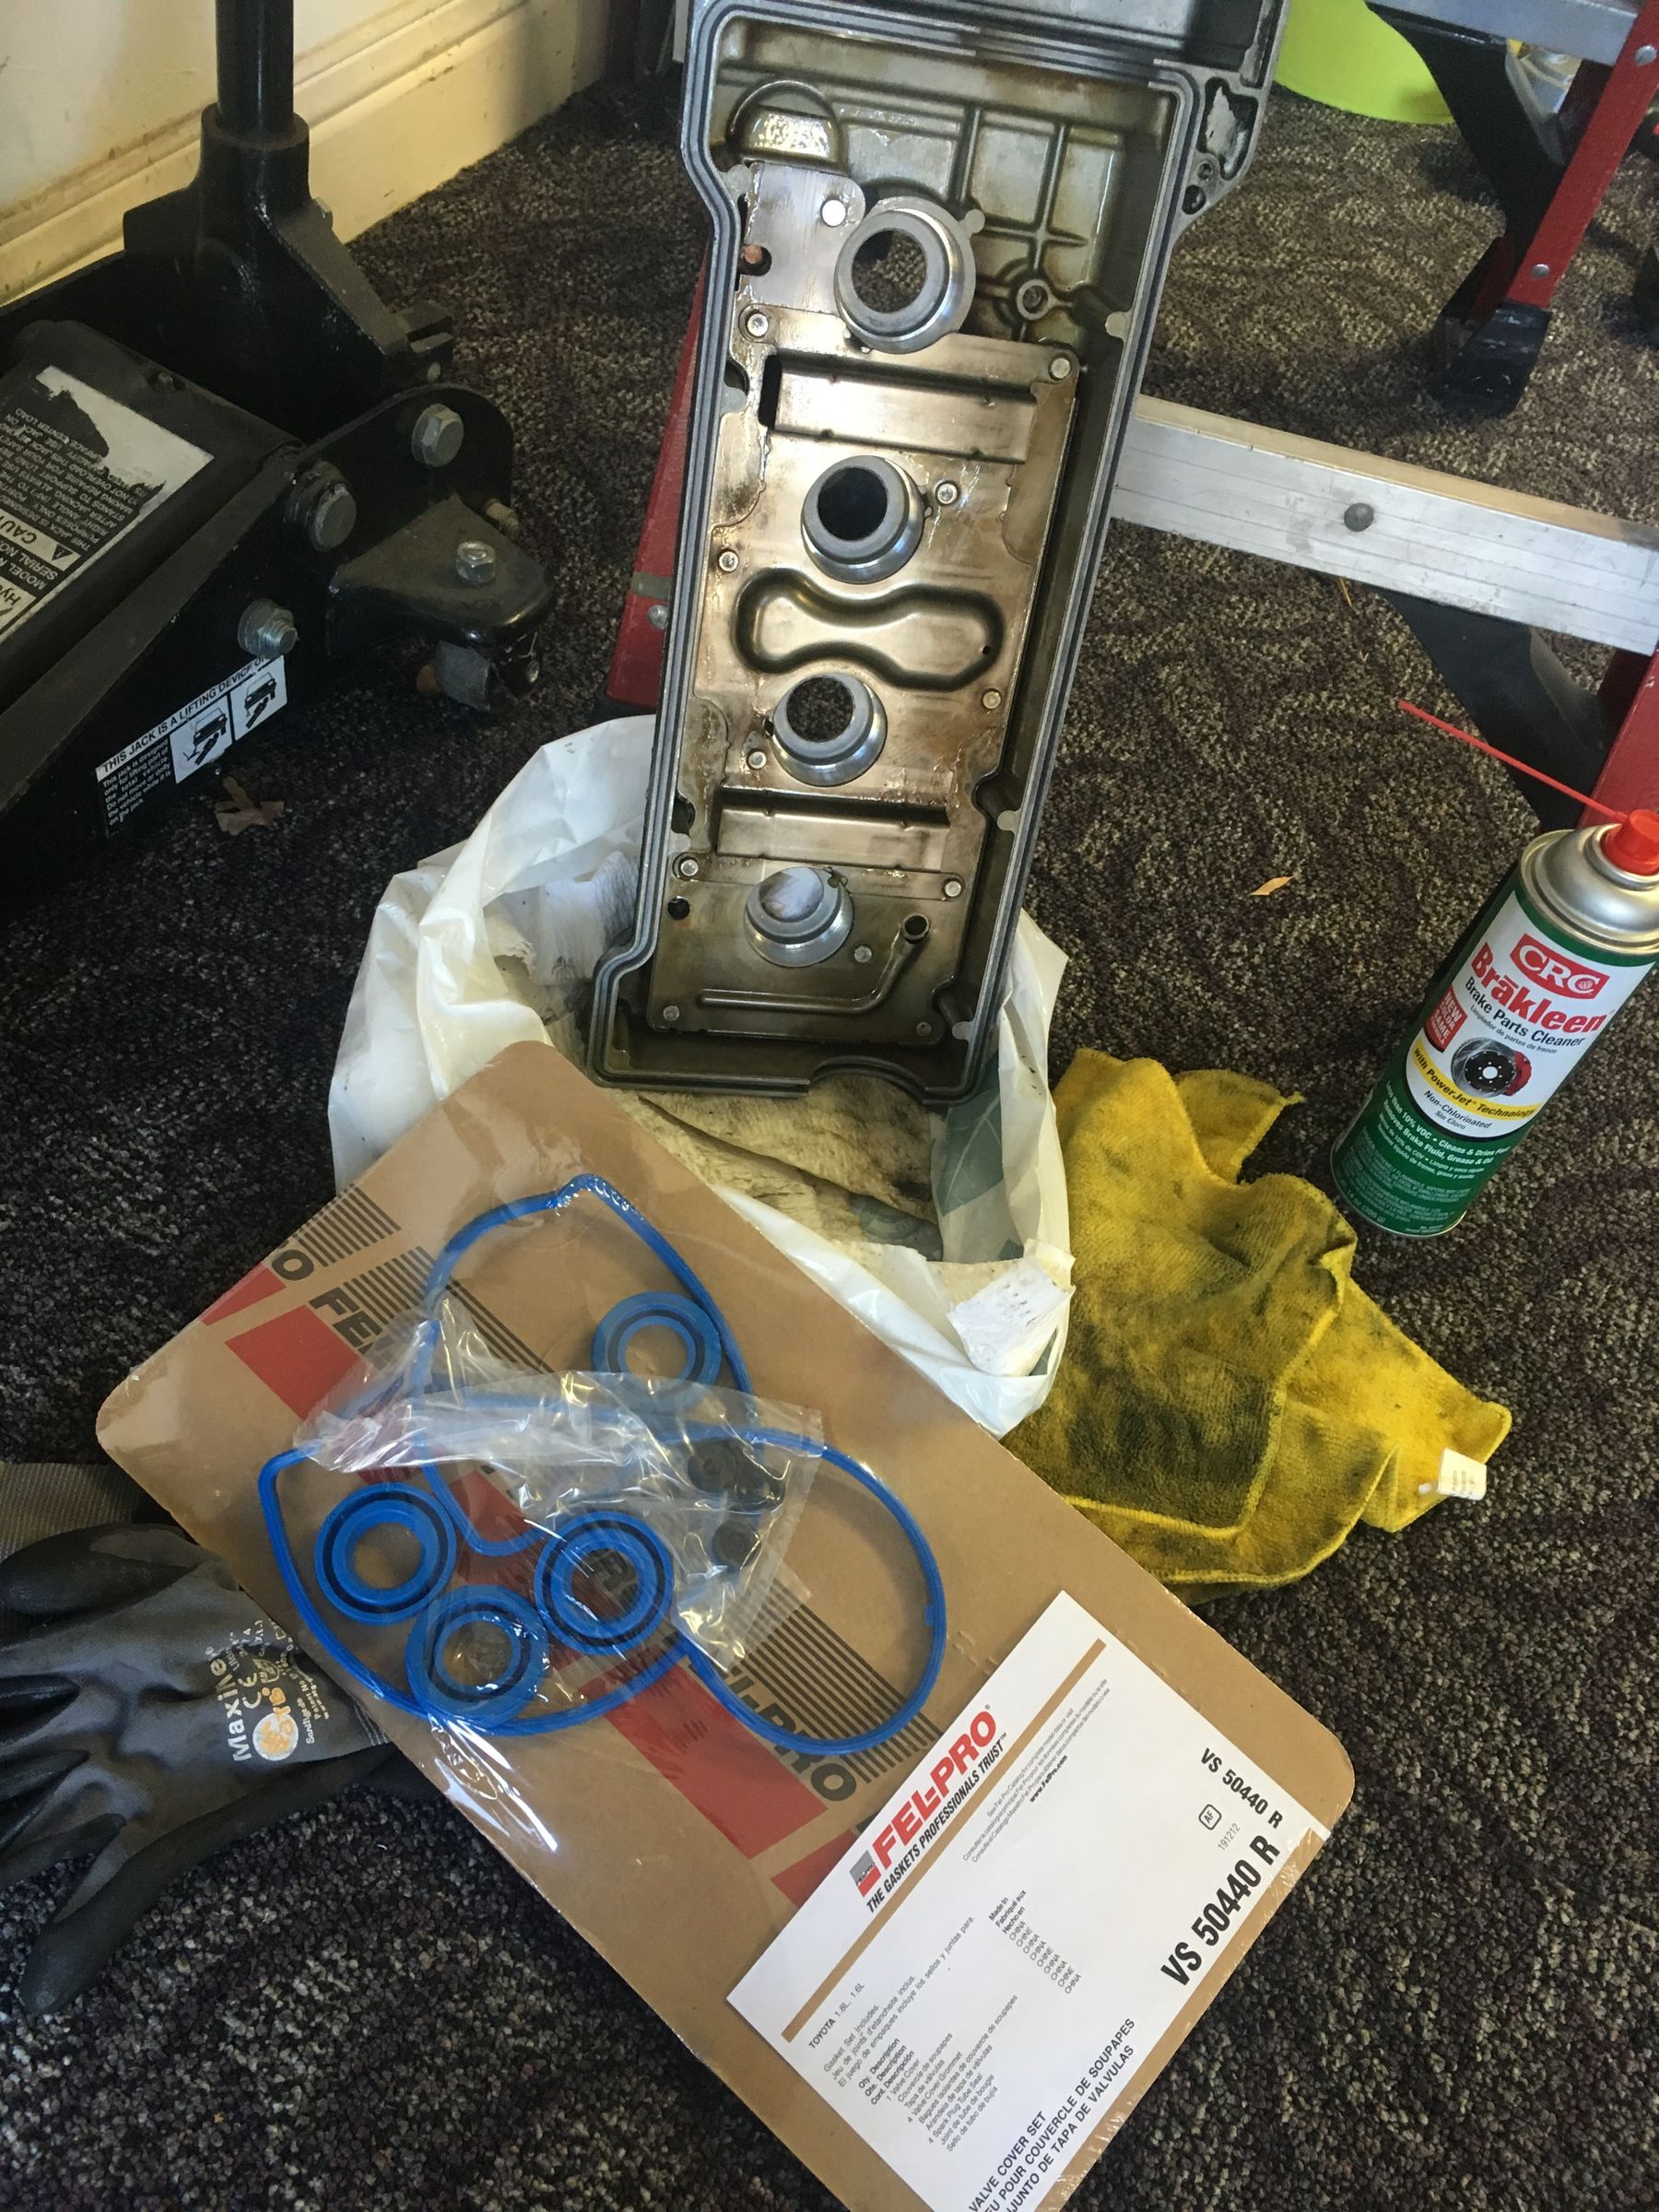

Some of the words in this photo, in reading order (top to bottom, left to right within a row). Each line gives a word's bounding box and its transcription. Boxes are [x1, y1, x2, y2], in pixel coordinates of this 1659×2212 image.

[46, 523, 73, 540] JACK
[0, 556, 7, 566] N
[4, 562, 48, 590] MODEL
[14, 552, 59, 581] SERIAL
[102, 747, 129, 774] THIS
[128, 728, 157, 756] JACK
[158, 721, 168, 735] IS
[170, 714, 177, 727] A
[179, 687, 217, 721] LIFTING
[218, 660, 254, 693] DEVICE
[1521, 943, 1600, 996] CRC
[1433, 1009, 1450, 1039] SAME
[1439, 1000, 1454, 1030] COLOR
[1444, 991, 1462, 1021] NEW
[1465, 976, 1492, 1013] Brake
[1493, 1008, 1529, 1036] Parts
[1531, 1029, 1585, 1046] Cleaner
[1470, 1005, 1497, 1030] Limpiador
[1504, 1032, 1526, 1046] partes
[1414, 1047, 1428, 1069] with
[1426, 1068, 1473, 1106] PowerJet
[1476, 1102, 1535, 1117] Technology
[1391, 1095, 1404, 1113] than
[1402, 1112, 1417, 1128] 10%
[1416, 1124, 1431, 1139] VOC
[1438, 1139, 1466, 1153] Cleans
[1424, 1089, 1492, 1129] Non-Chlorinated
[1434, 1110, 1447, 1121] Sin
[1446, 1117, 1465, 1130] Cloro
[1382, 1099, 1404, 1130] Removes
[1402, 1127, 1424, 1147] Brake
[1423, 1144, 1446, 1159] Fluid,
[1446, 1152, 1475, 1165] Grease
[871, 1712, 995, 1870] FEL-PRO
[1028, 1753, 1068, 1803] www.FelPro.com
[1197, 1746, 1224, 1774] VS
[1220, 1766, 1270, 1818] 50440
[1266, 1809, 1285, 1830] R
[865, 1888, 886, 1913] THE
[880, 1842, 923, 1893] GASKETS
[916, 1770, 982, 1849] PROFESSIONALS
[976, 1738, 1007, 1774] TRUST
[1202, 1808, 1216, 1824] AF
[1216, 1821, 1241, 1852] 191212
[988, 1901, 1004, 1921] Made
[994, 1899, 1018, 1928] Fabriqué
[1015, 1888, 1028, 1903] aux
[1002, 1912, 1019, 1934] Hecho
[1016, 1904, 1025, 1916] en
[1159, 1937, 1205, 1991] VS
[1188, 1855, 1265, 1949] 50440
[1248, 1830, 1280, 1866] R
[1008, 1919, 1026, 1941] CHINA
[1015, 1925, 1033, 1947] CHINE
[1021, 1932, 1040, 1954] CHINA
[1029, 1938, 1047, 1961] CHINA
[1035, 1946, 1053, 1968] CHINE
[1042, 1952, 1061, 1974] CHINA
[1049, 1959, 1067, 1981] CHINA
[1056, 1965, 1075, 1988] CHINE
[1064, 1972, 1081, 1994] CHINA
[837, 2077, 848, 2088] El
[844, 2056, 864, 2079] juego
[860, 2046, 872, 2059] de
[868, 2012, 899, 2049] empaques
[896, 1988, 917, 2014] incluye
[914, 1977, 926, 1991] los
[923, 1957, 941, 1978] sellos
[943, 1931, 962, 1954] juntas
[807, 2016, 836, 2050] TOYOTA
[822, 2046, 845, 2073] Gasket
[842, 2031, 856, 2047] Set
[830, 2065, 844, 2081] Jeu
[841, 2053, 853, 2066] de
[850, 2034, 868, 2055] joints
[857, 2073, 872, 2089] Qty.
[869, 2036, 900, 2075] Description
[864, 2080, 878, 2098] Qte.
[876, 2043, 907, 2082] Description
[883, 2049, 915, 2088] Descripción
[890, 2077, 906, 2096] Valve
[903, 2057, 921, 2079] Cover
[897, 2068, 924, 2103] Couvercle
[920, 2060, 931, 2072] de
[927, 2031, 953, 2064] soupapes
[918, 2097, 940, 2124] Bagues
[936, 2069, 960, 2100] isolantes
[957, 2061, 968, 2073] de
[964, 2031, 990, 2064] couvercle
[986, 2023, 996, 2035] de
[993, 1994, 1019, 2026] soupapes
[904, 2091, 920, 2110] Tapa
[915, 2082, 926, 2095] de
[911, 2097, 927, 2117] Valve
[924, 2078, 941, 2100] Cover
[937, 2051, 963, 2082] Grommet
[924, 2100, 949, 2131] Arandela
[946, 2091, 957, 2103] de
[953, 2077, 968, 2094] tapa
[964, 2068, 974, 2080] de
[932, 2116, 950, 2138] Spark
[946, 2101, 961, 2120] Plug
[958, 2086, 973, 2105] Tube
[969, 2072, 984, 2090] Seal
[939, 2126, 955, 2146] Joint
[951, 2118, 961, 2130] de
[958, 2103, 972, 2121] tube
[969, 2094, 980, 2107] de
[975, 2073, 995, 2098] bougie
[997, 2163, 1027, 2201] POUR
[1023, 2094, 1078, 2167] COUVERCLE
[1074, 2076, 1091, 2098] DE
[1088, 2017, 1135, 2079] SOUPAPES
[946, 2134, 961, 2153] Sello
[958, 2124, 969, 2136] de
[965, 2109, 980, 2127] tubo
[976, 2100, 987, 2112] de
[1006, 2171, 1041, 2212] JUNTO
[1037, 2151, 1054, 2173] DE
[1050, 2120, 1078, 2155] TAPA
[1074, 2101, 1091, 2123] DE
[1088, 2043, 1135, 2104] VALVULAS
[968, 2174, 1000, 2212] VALVE
[995, 2134, 1030, 2178] COVER
[1026, 2110, 1048, 2137] SET
